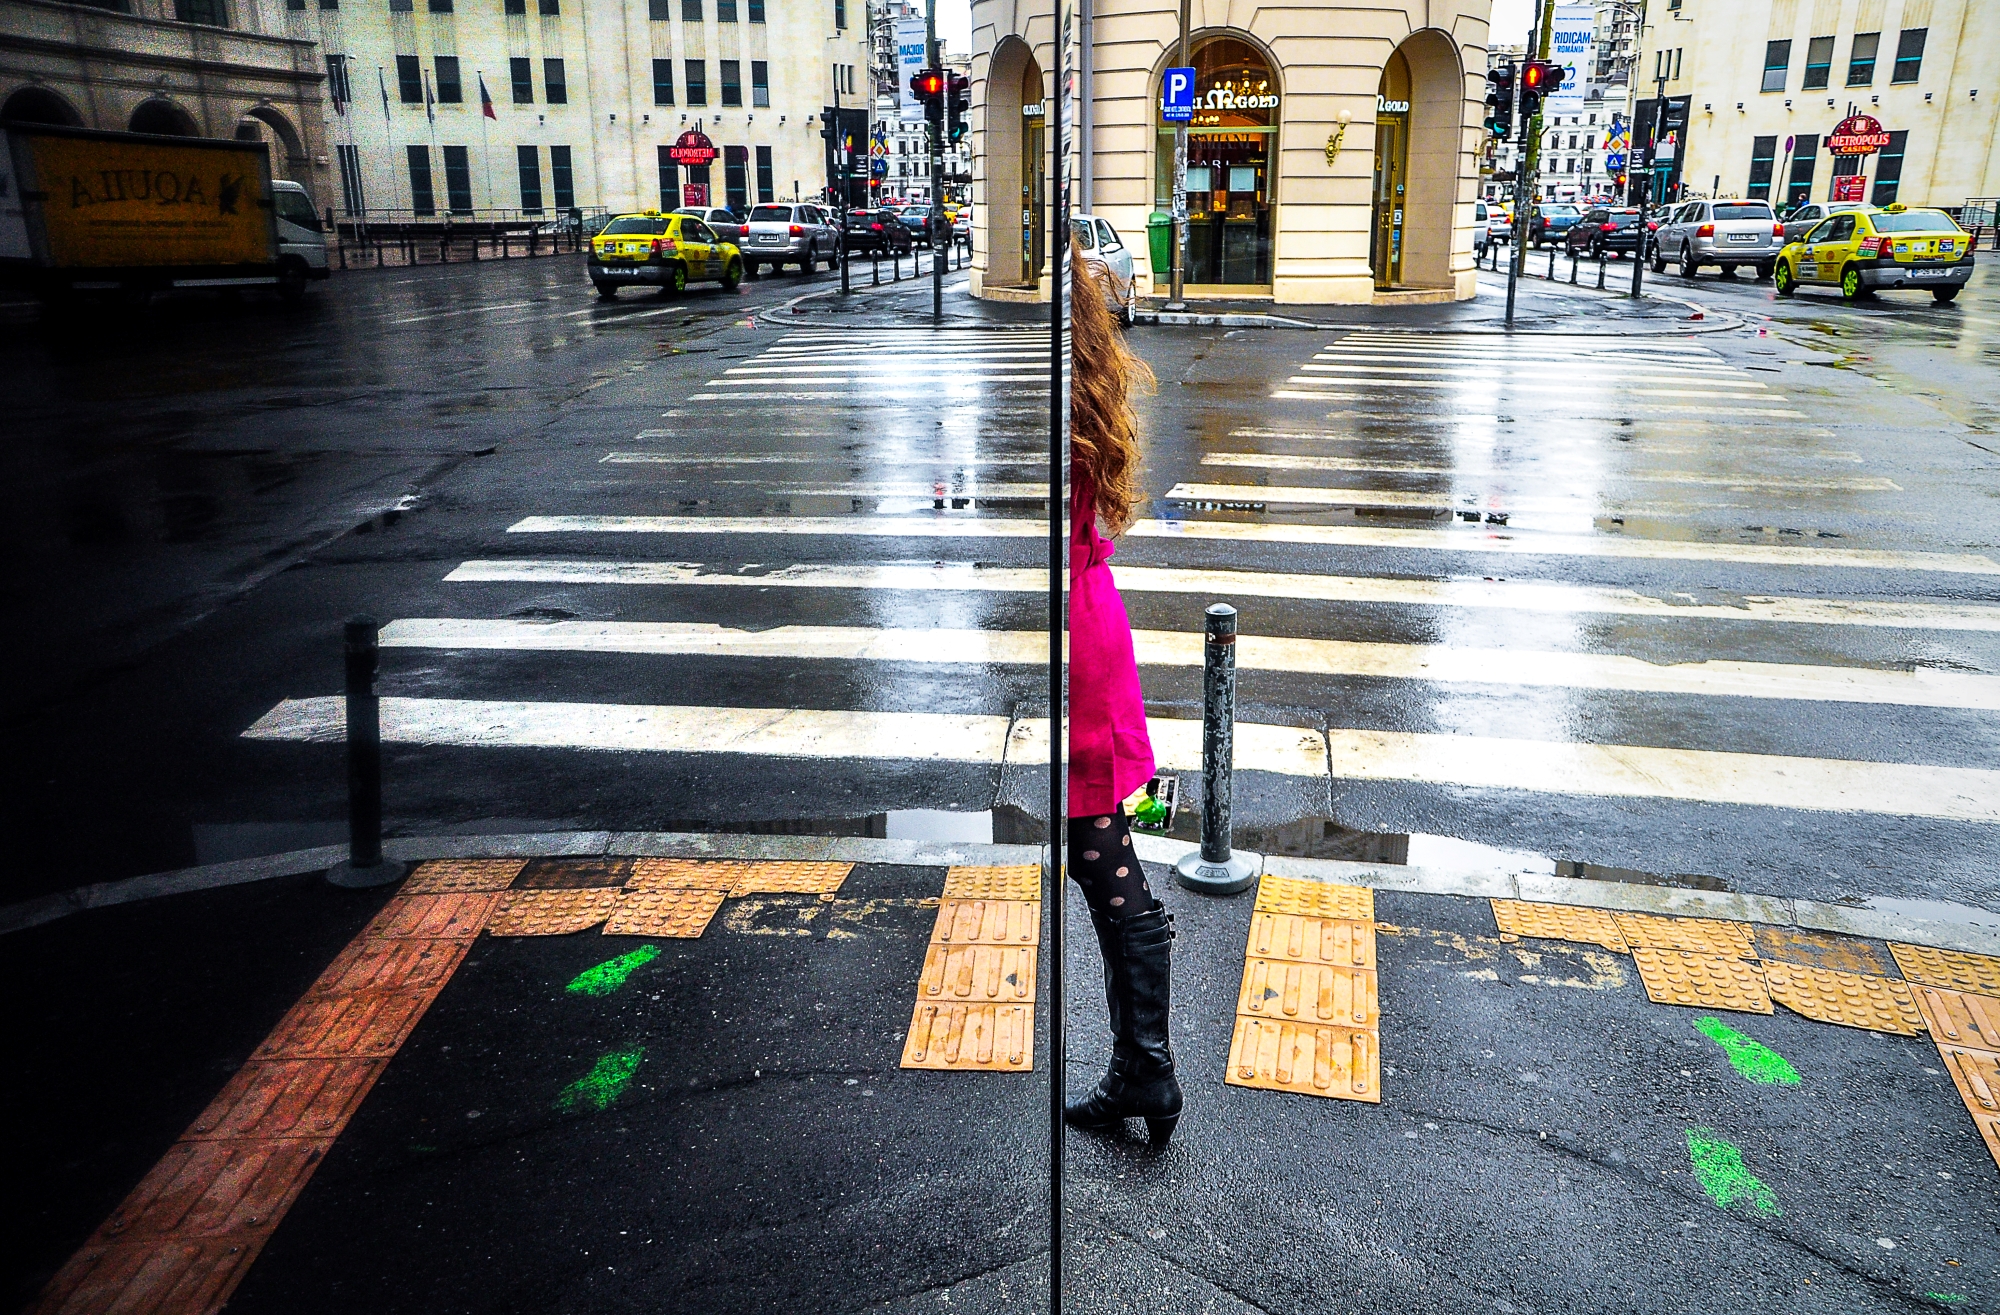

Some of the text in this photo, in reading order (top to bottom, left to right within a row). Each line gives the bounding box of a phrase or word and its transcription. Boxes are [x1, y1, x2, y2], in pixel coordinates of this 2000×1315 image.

[1170, 74, 1187, 103] P
[1237, 95, 1279, 109] GOLD
[1385, 101, 1409, 111] GOLD
[1830, 134, 1889, 146] METROPOLIS
